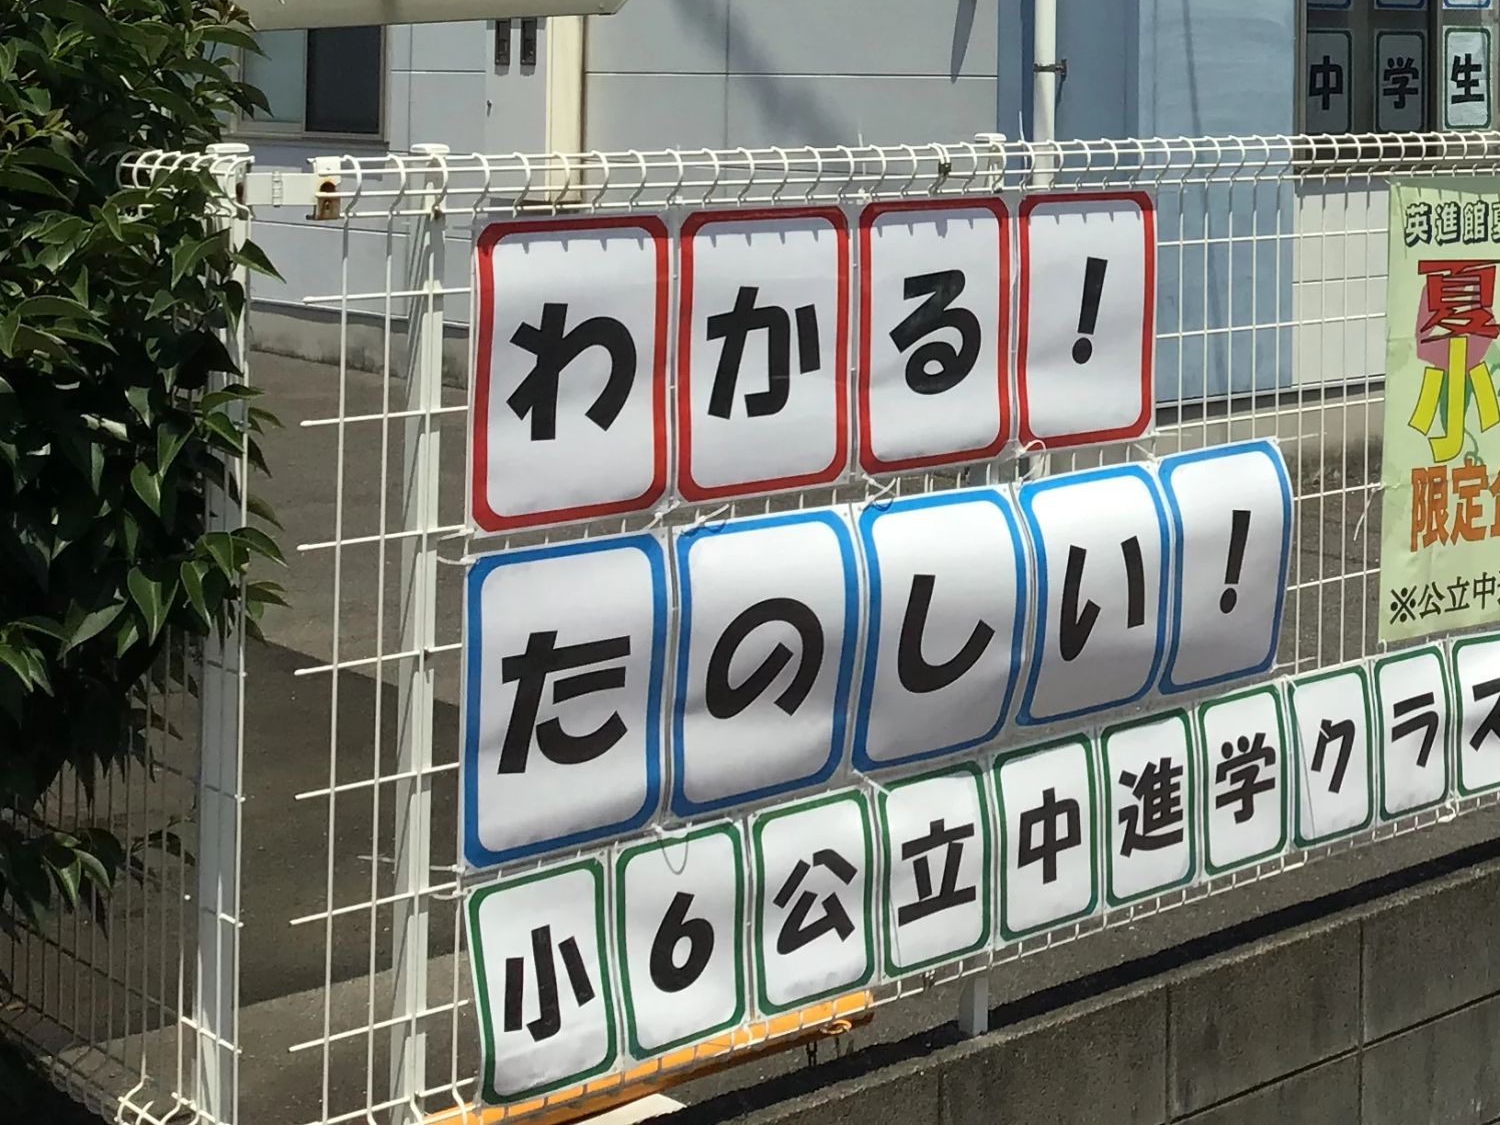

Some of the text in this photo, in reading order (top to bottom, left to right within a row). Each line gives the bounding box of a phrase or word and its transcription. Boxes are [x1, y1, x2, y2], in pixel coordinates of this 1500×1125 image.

[506, 256, 1109, 441] わかる！
[498, 509, 1251, 775] たのしい！
